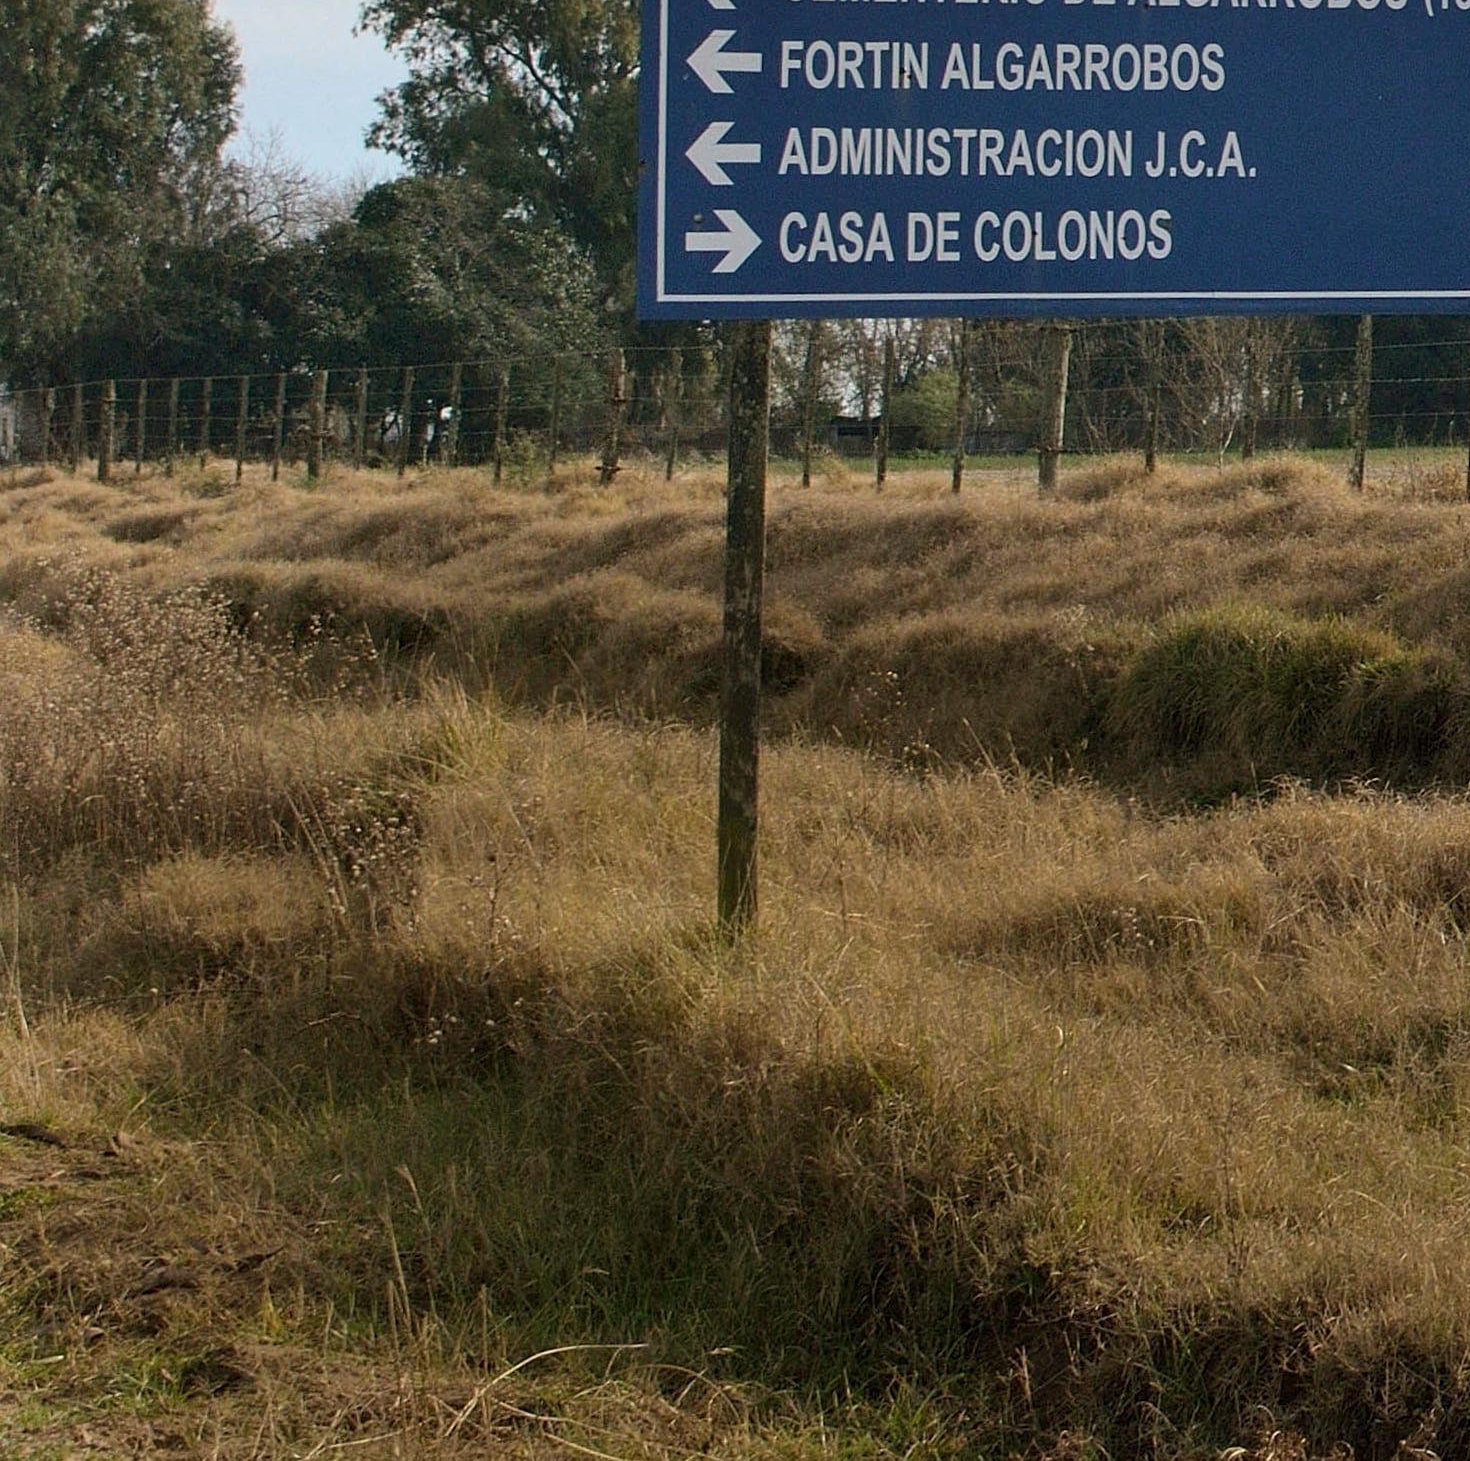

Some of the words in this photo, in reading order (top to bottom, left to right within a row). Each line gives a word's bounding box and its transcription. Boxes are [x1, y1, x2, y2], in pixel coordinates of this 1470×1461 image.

[781, 41, 928, 88] FORTIN
[941, 43, 1224, 90] ALGARROBOS
[779, 128, 1131, 176] ADMINISTRACION
[1146, 131, 1256, 177] J.C.A.
[780, 212, 894, 262] CASA
[908, 213, 960, 261] DE
[975, 210, 1171, 261] COLONOS
